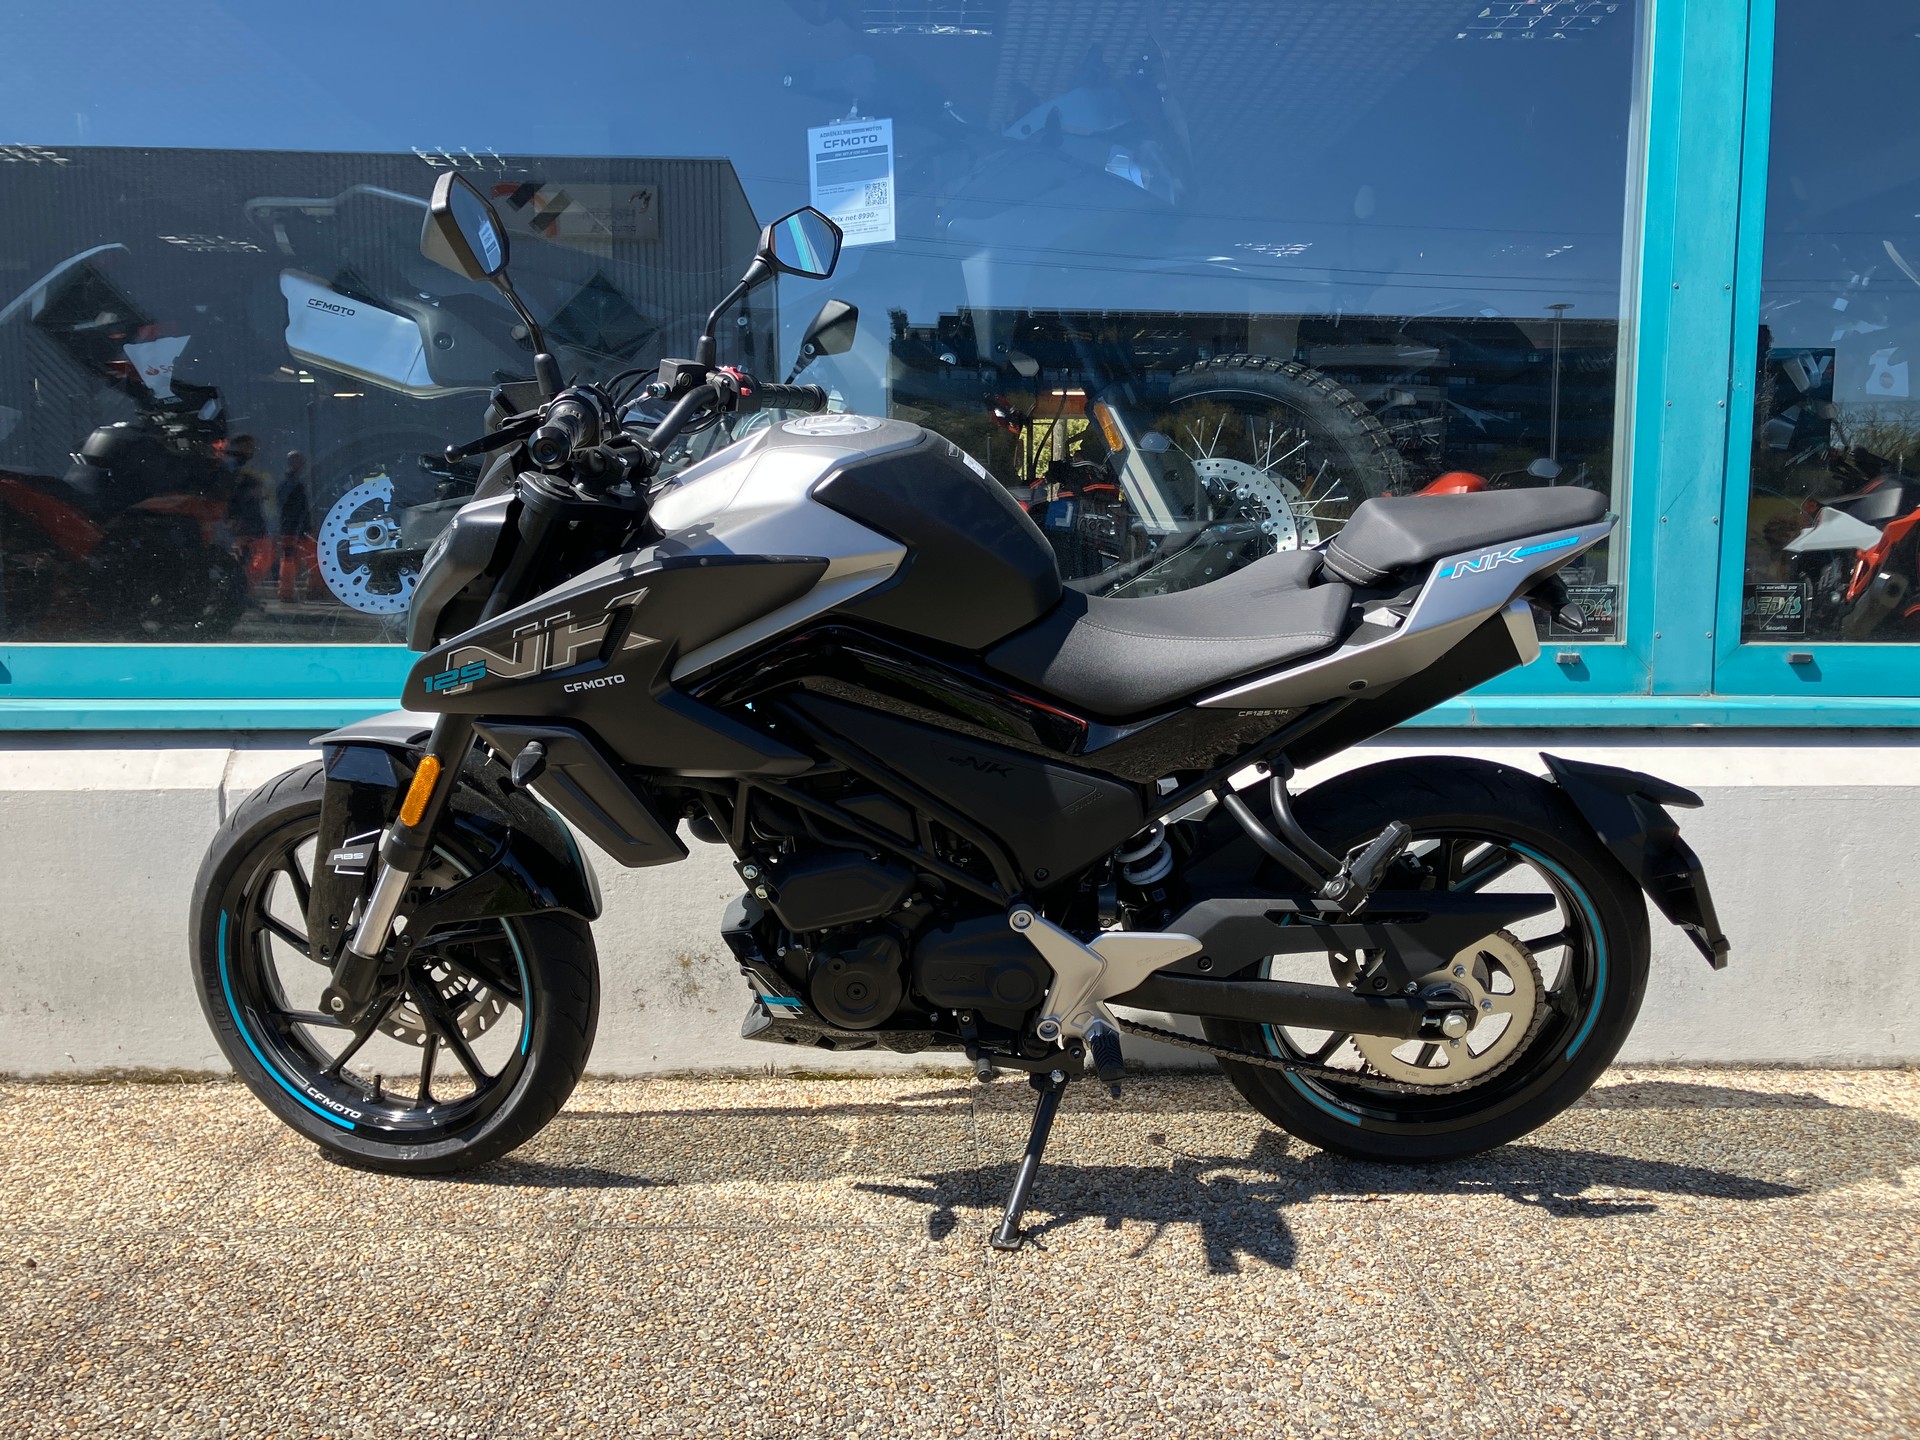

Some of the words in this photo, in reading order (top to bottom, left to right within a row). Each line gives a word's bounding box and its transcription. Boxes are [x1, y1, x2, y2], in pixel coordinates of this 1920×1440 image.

[823, 135, 878, 149] CFMOTO
[307, 298, 356, 316] CFMOTO
[1450, 546, 1524, 580] NK
[443, 586, 662, 695] NK
[423, 659, 487, 693] 125
[563, 673, 626, 693] CFMOTO
[333, 852, 364, 861] ABS
[307, 1087, 362, 1119] CFMOTO
